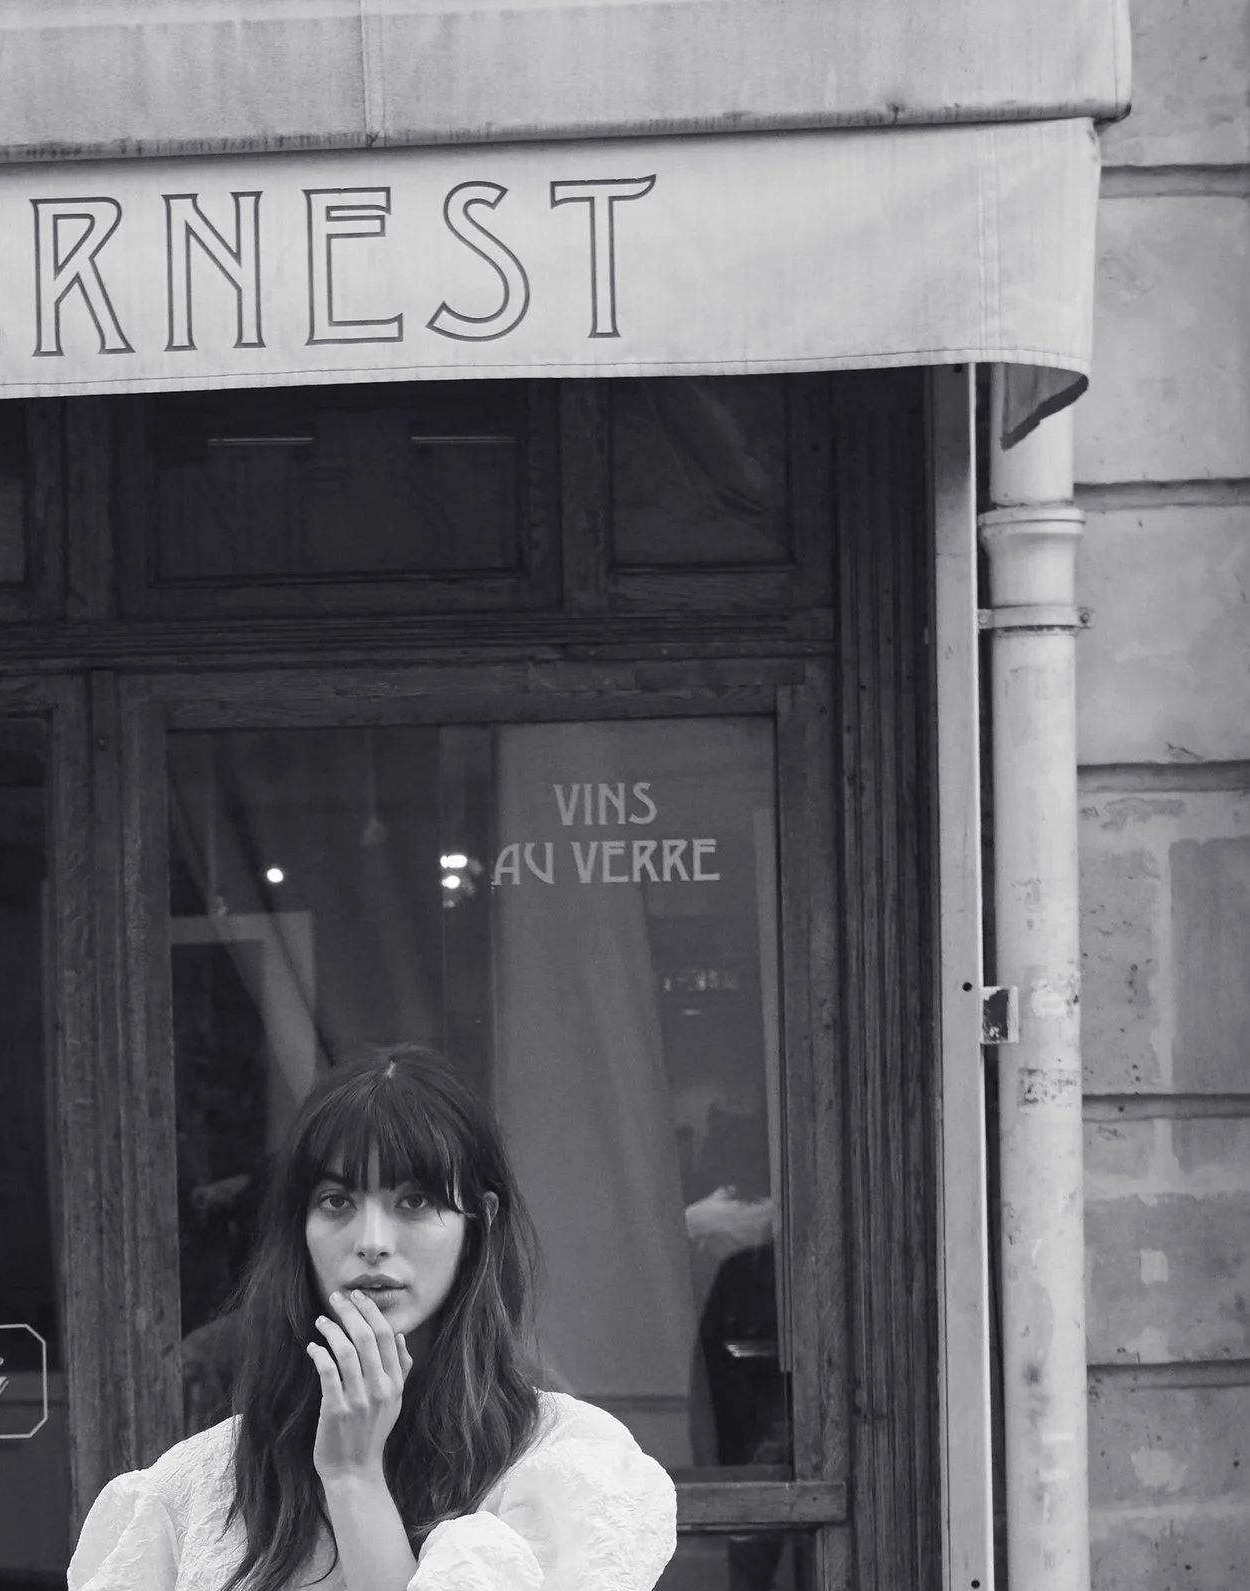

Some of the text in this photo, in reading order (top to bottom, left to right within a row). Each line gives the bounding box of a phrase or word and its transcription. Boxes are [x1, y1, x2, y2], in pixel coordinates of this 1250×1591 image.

[553, 782, 658, 826] VINS
[492, 838, 720, 886] AU VERRE
